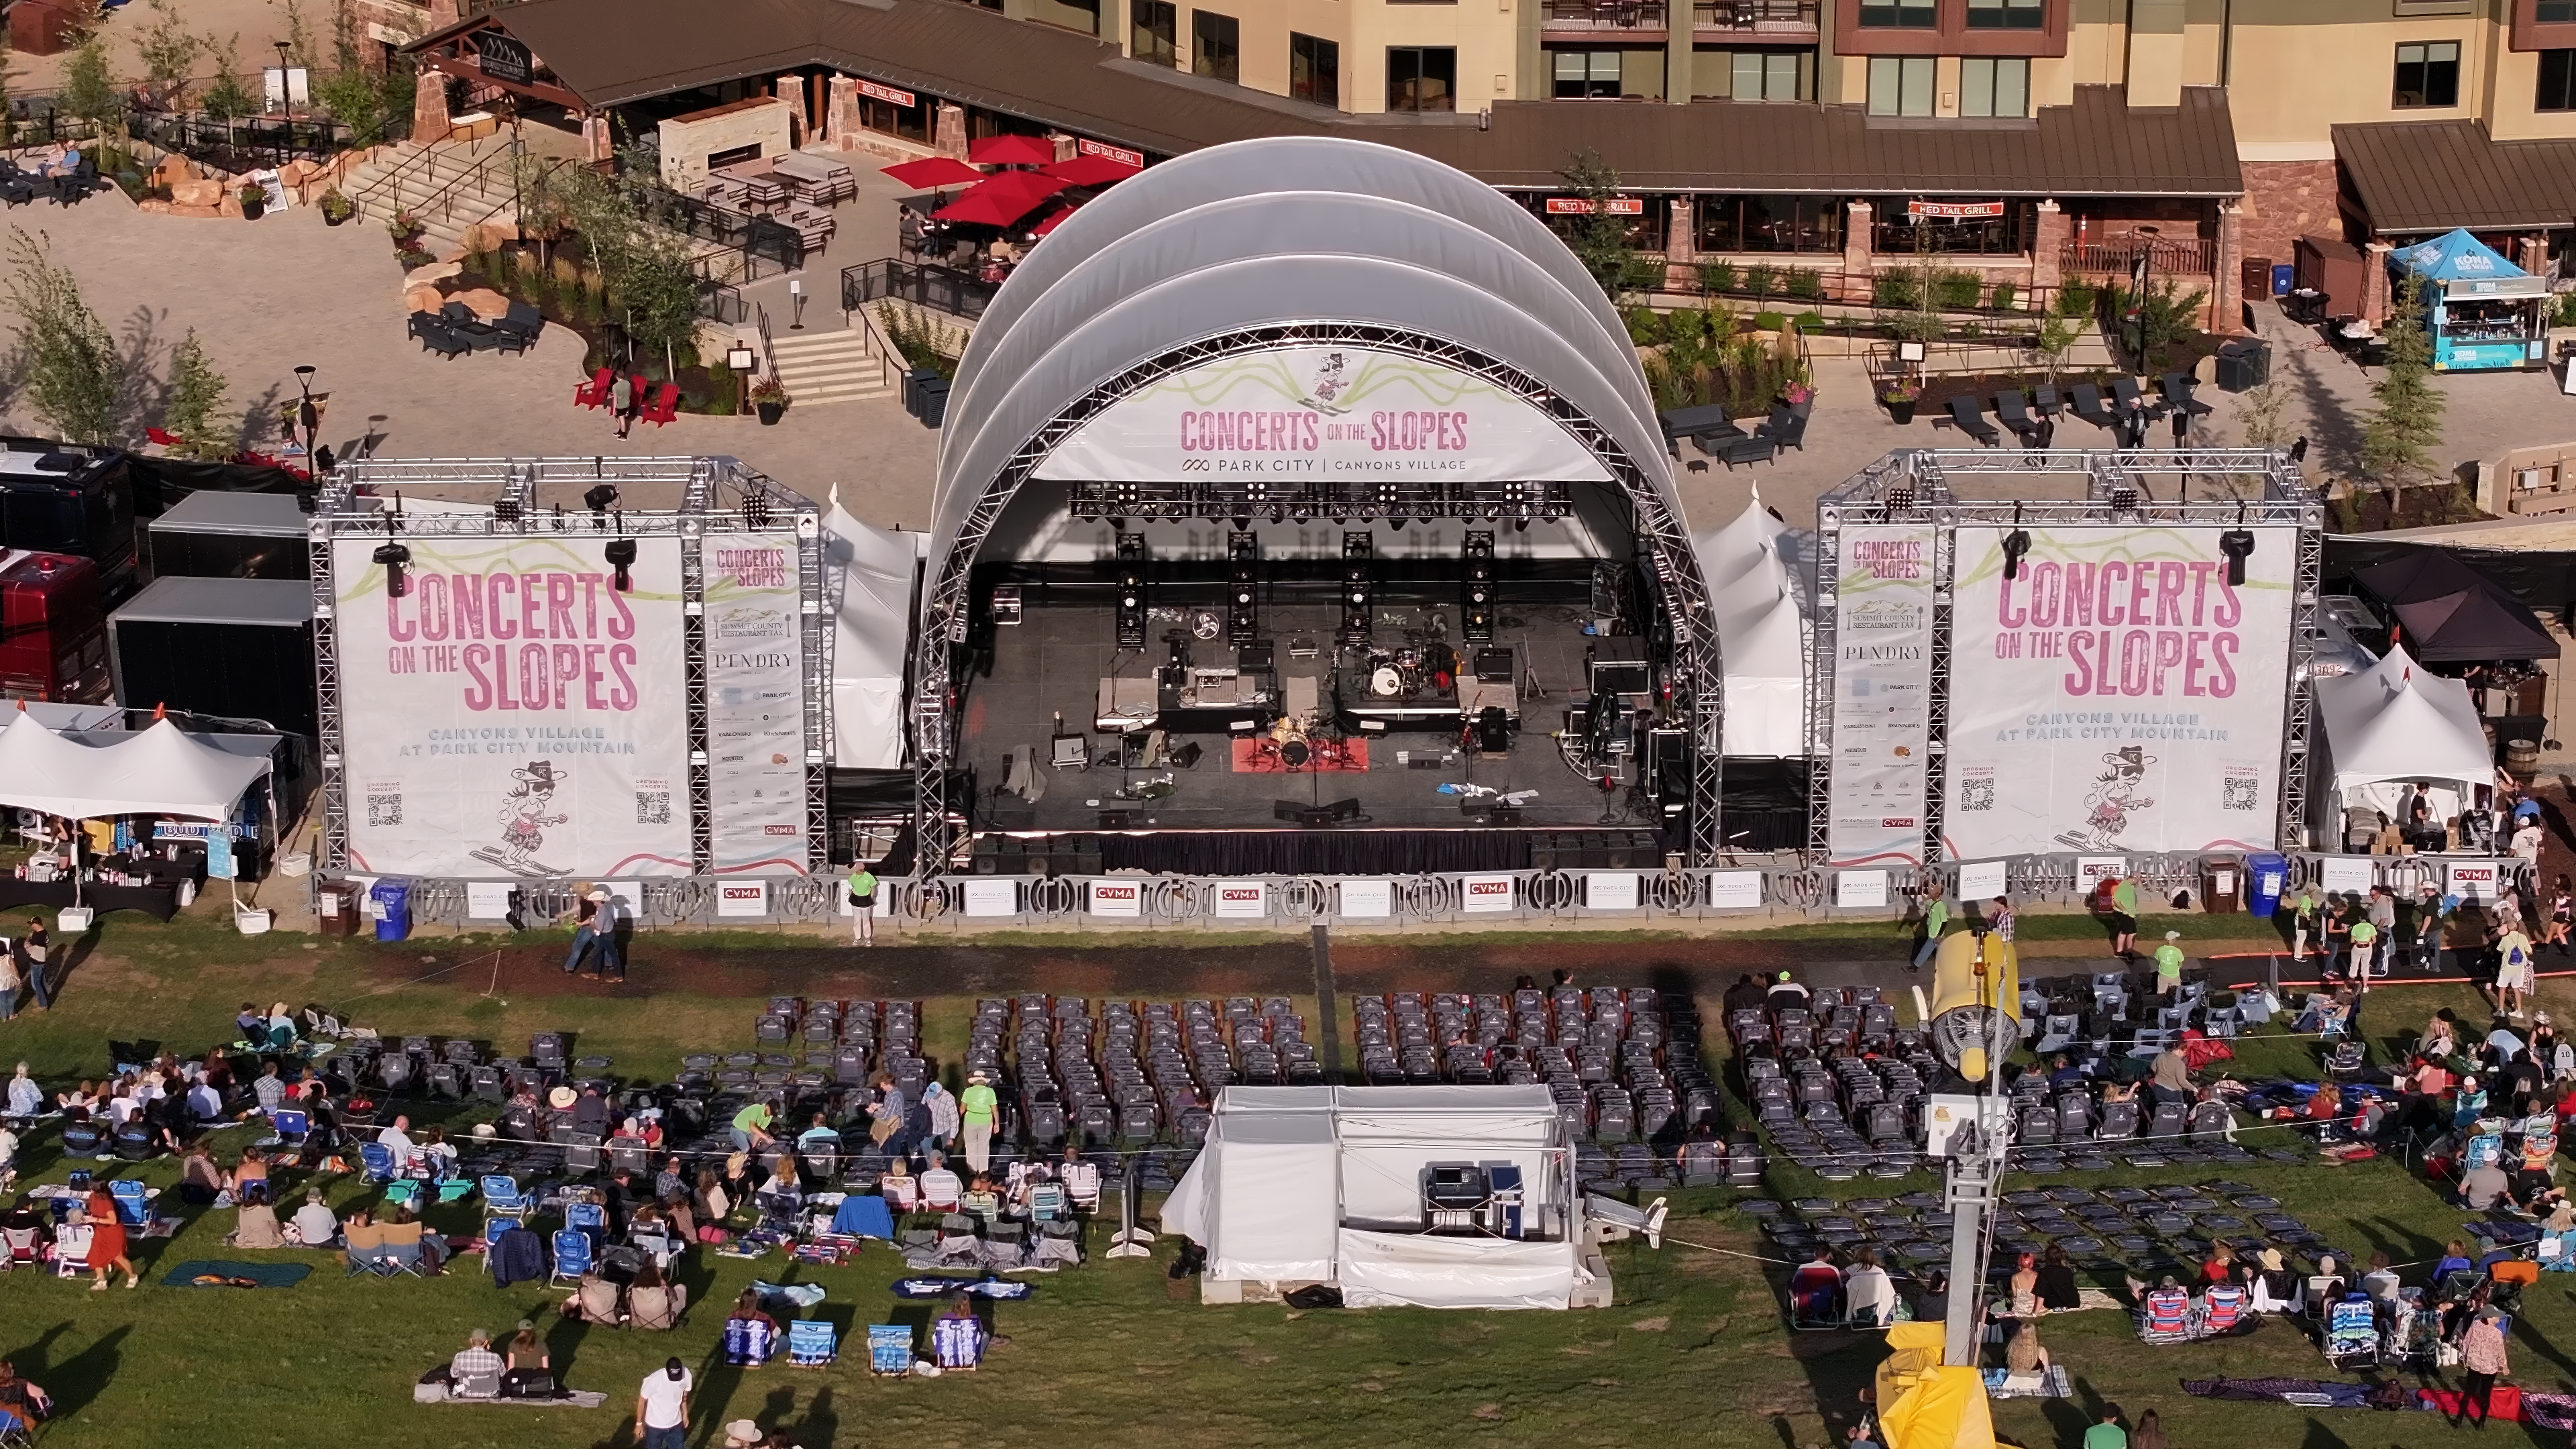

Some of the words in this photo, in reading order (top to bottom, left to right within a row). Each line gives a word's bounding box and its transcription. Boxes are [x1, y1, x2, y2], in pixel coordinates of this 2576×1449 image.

[264, 73, 273, 113] WELCOME
[863, 84, 875, 94] RED
[875, 87, 888, 99] TAIL
[889, 92, 907, 103] GRILL
[1086, 143, 1099, 154] RED
[1100, 147, 1114, 158] TAIL
[1115, 151, 1135, 164] GRILL
[1558, 203, 1577, 211] RED
[1942, 207, 1962, 215] TAIL
[1964, 206, 1993, 214] GRILL
[2453, 255, 2492, 266] KONA
[1181, 411, 1319, 451] CONCERTS
[1327, 424, 1342, 440] ON
[1346, 423, 1366, 440] THE
[1371, 411, 1468, 451] SLOPES
[1219, 460, 1264, 471] PARK
[1273, 460, 1313, 471] CITY
[1335, 460, 1401, 470] CANYONS
[1409, 460, 1466, 470] VILLAGE
[1854, 541, 1921, 559] CONCERTS
[716, 549, 785, 568] CONCERTS
[1872, 560, 1921, 578] SLOPES
[738, 568, 785, 586] SLOPES
[1999, 561, 2241, 629] CONCERTS
[388, 573, 635, 642] CONCERTS
[720, 629, 767, 637] RESTAURANT
[1843, 645, 1923, 660] PENDRY
[716, 653, 791, 667] PENDRY
[1995, 632, 2021, 659] ON
[2029, 632, 2063, 659] THE
[2065, 629, 2240, 698] SLOPES
[389, 647, 416, 674] ON
[422, 645, 458, 672] THE
[463, 643, 637, 711] SLOPES
[2026, 712, 2113, 725] CANYONS
[2121, 712, 2199, 724] VILLAGE
[429, 727, 518, 740] CANYONS
[526, 727, 605, 739] VILLAGE
[1996, 730, 2019, 741] AT
[2026, 728, 2073, 739] PARK
[2080, 727, 2123, 738] CITY
[2131, 727, 2229, 741] MOUNTAIN
[400, 744, 422, 757] AT
[429, 742, 479, 755] PARK
[487, 742, 529, 753] CITY
[538, 742, 635, 754] MOUNTAIN
[2129, 753, 2137, 762] PC
[164, 825, 199, 836] BUD
[2455, 871, 2490, 879] CVMA
[724, 890, 759, 898] CVMA
[1097, 888, 1133, 898] CVMA
[1224, 891, 1258, 899] CVMA
[1470, 883, 1506, 894] CVMA
